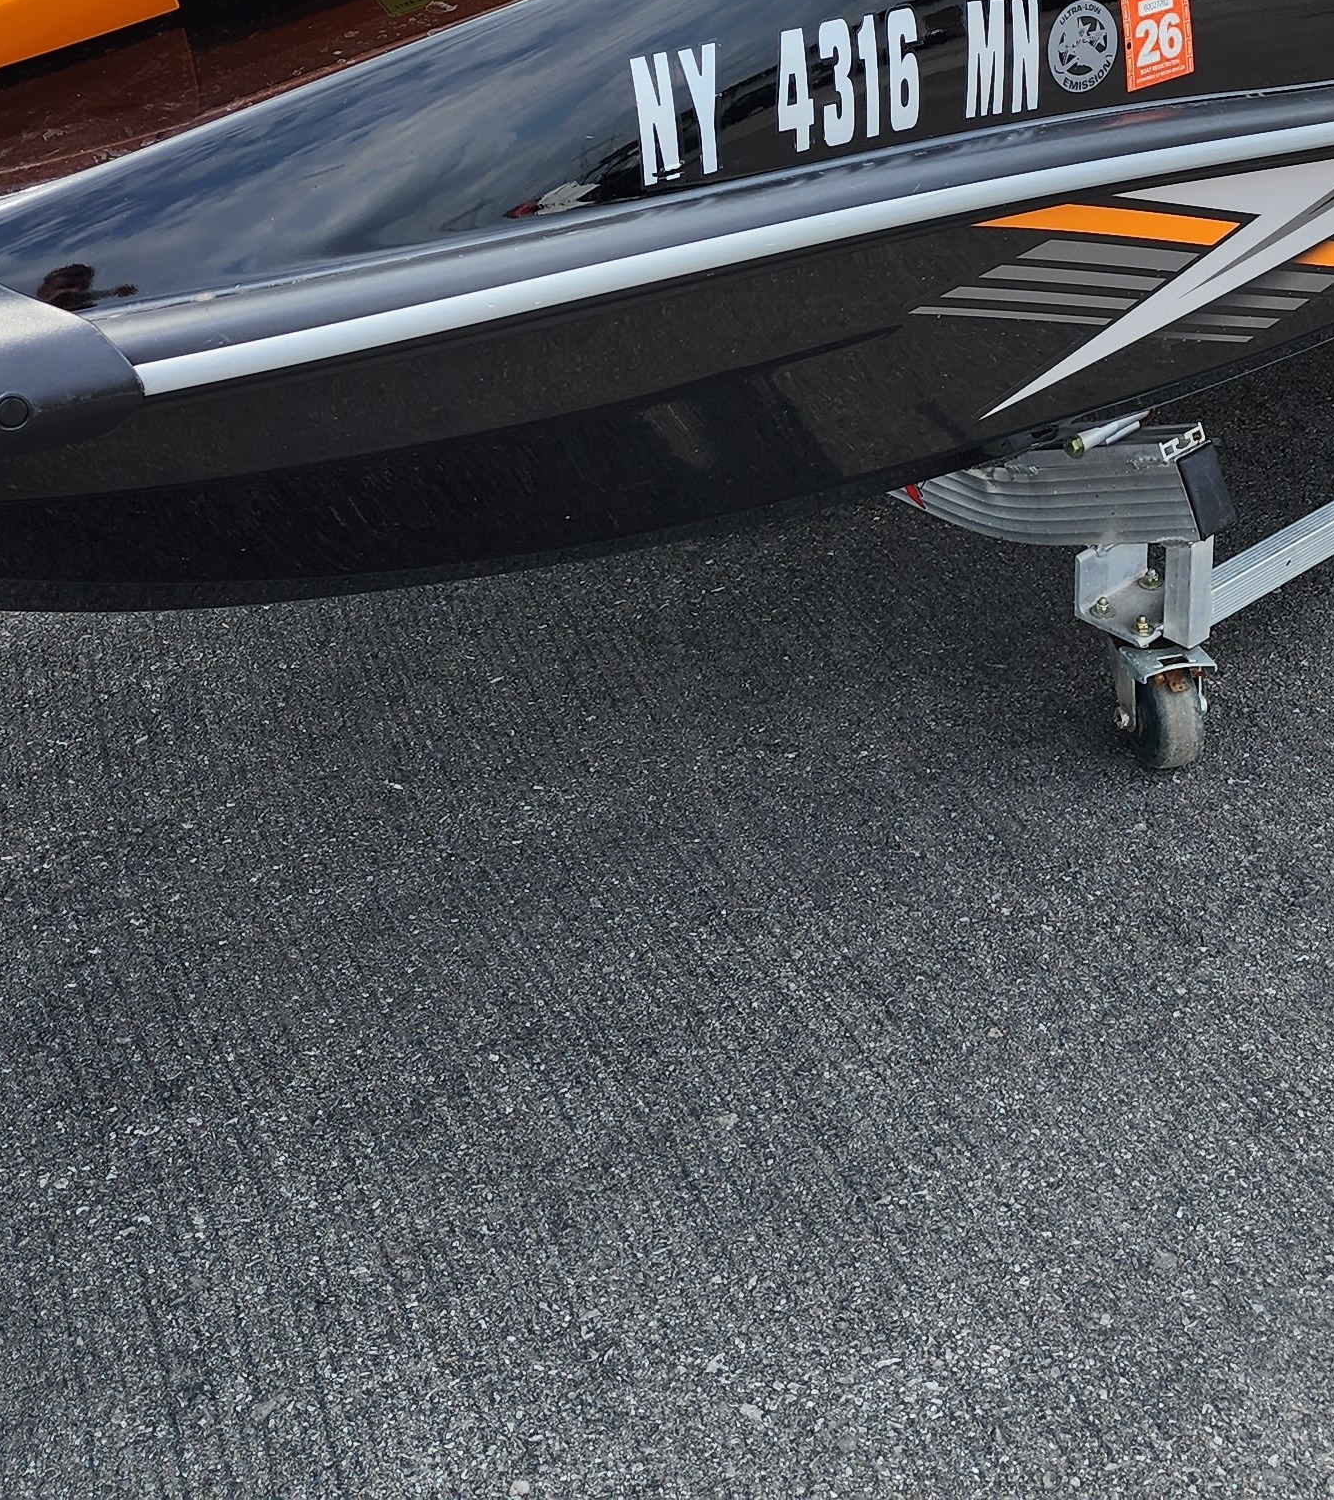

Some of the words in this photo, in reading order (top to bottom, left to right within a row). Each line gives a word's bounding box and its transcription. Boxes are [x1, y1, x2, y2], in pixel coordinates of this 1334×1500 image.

[1059, 3, 1102, 26] ULTRA-LOW
[1135, 12, 1183, 68] 26
[628, 41, 718, 187] NY
[777, 5, 919, 152] 4316
[1062, 59, 1112, 91] EMISSION
